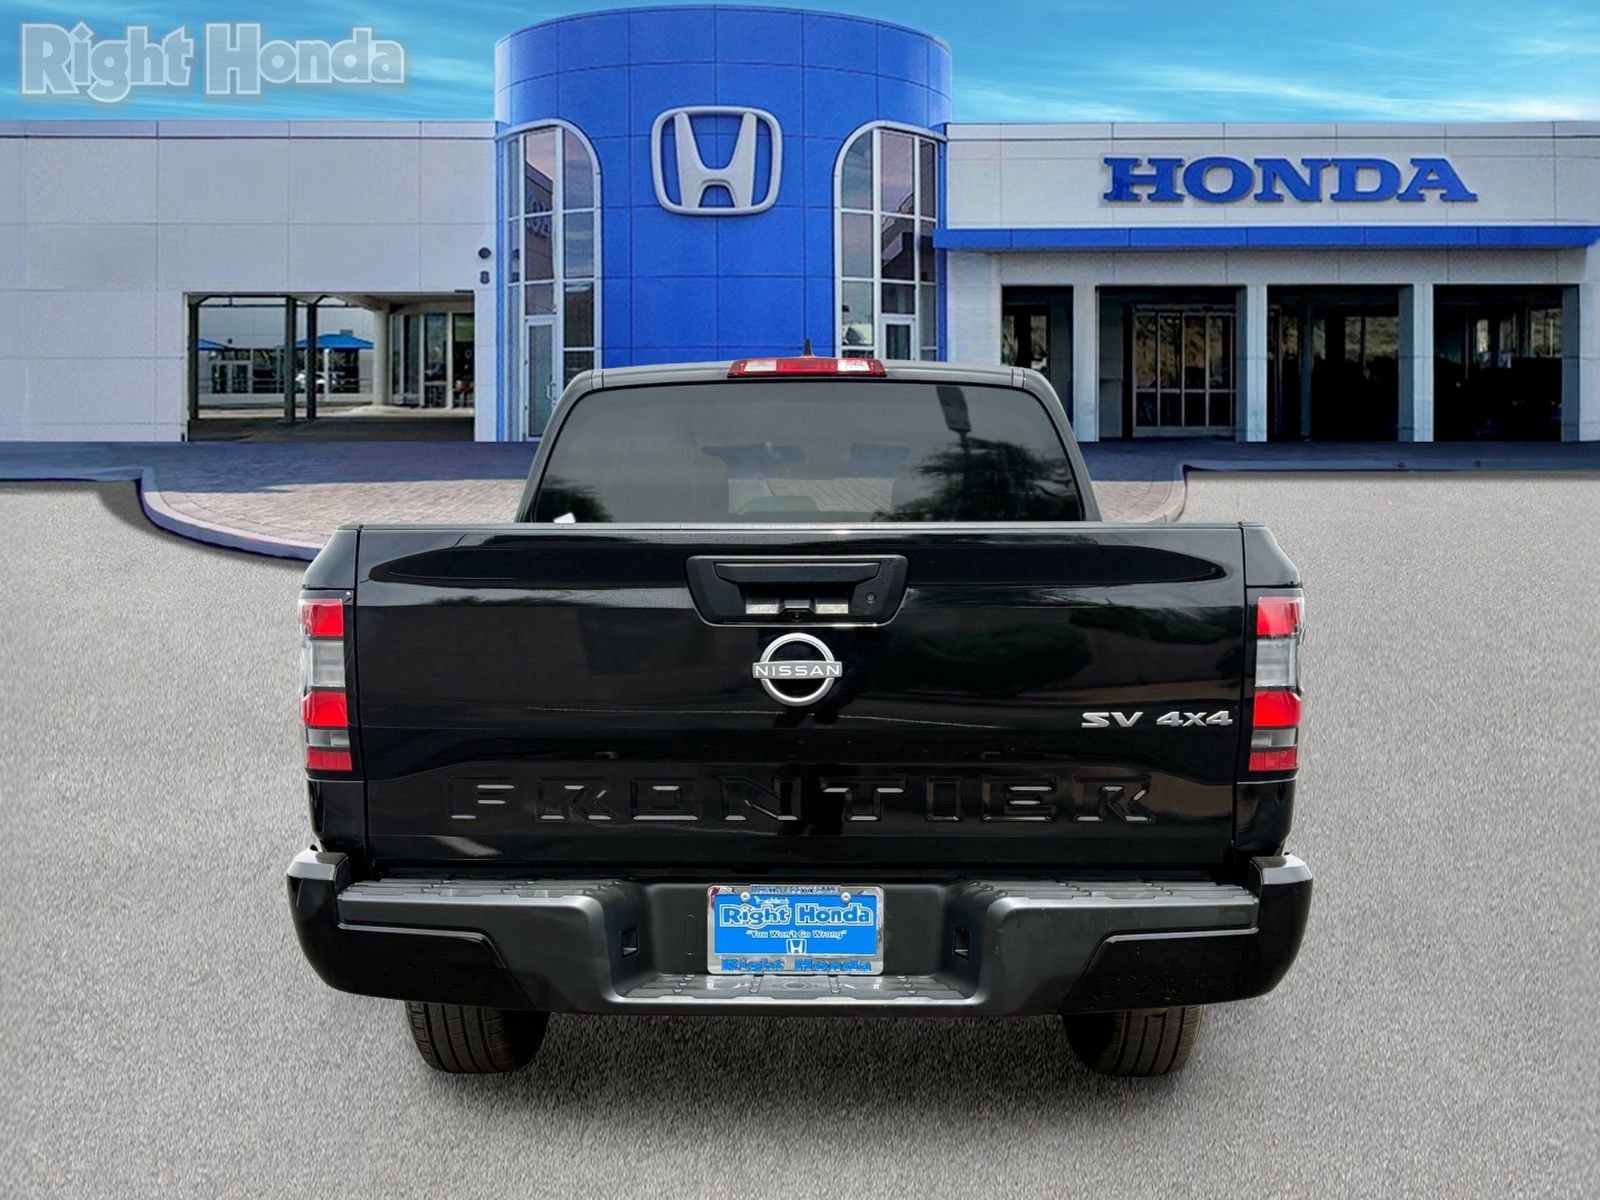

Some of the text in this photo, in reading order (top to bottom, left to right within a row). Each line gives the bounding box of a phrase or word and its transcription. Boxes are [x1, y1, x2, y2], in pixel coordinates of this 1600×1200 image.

[1103, 156, 1478, 202] HONDA
[754, 664, 840, 677] NISSAN
[1081, 710, 1234, 728] SV 4x4
[448, 775, 1158, 823] FRONTIER
[720, 903, 874, 928] Right Honda
[721, 958, 872, 972] Right Honda
